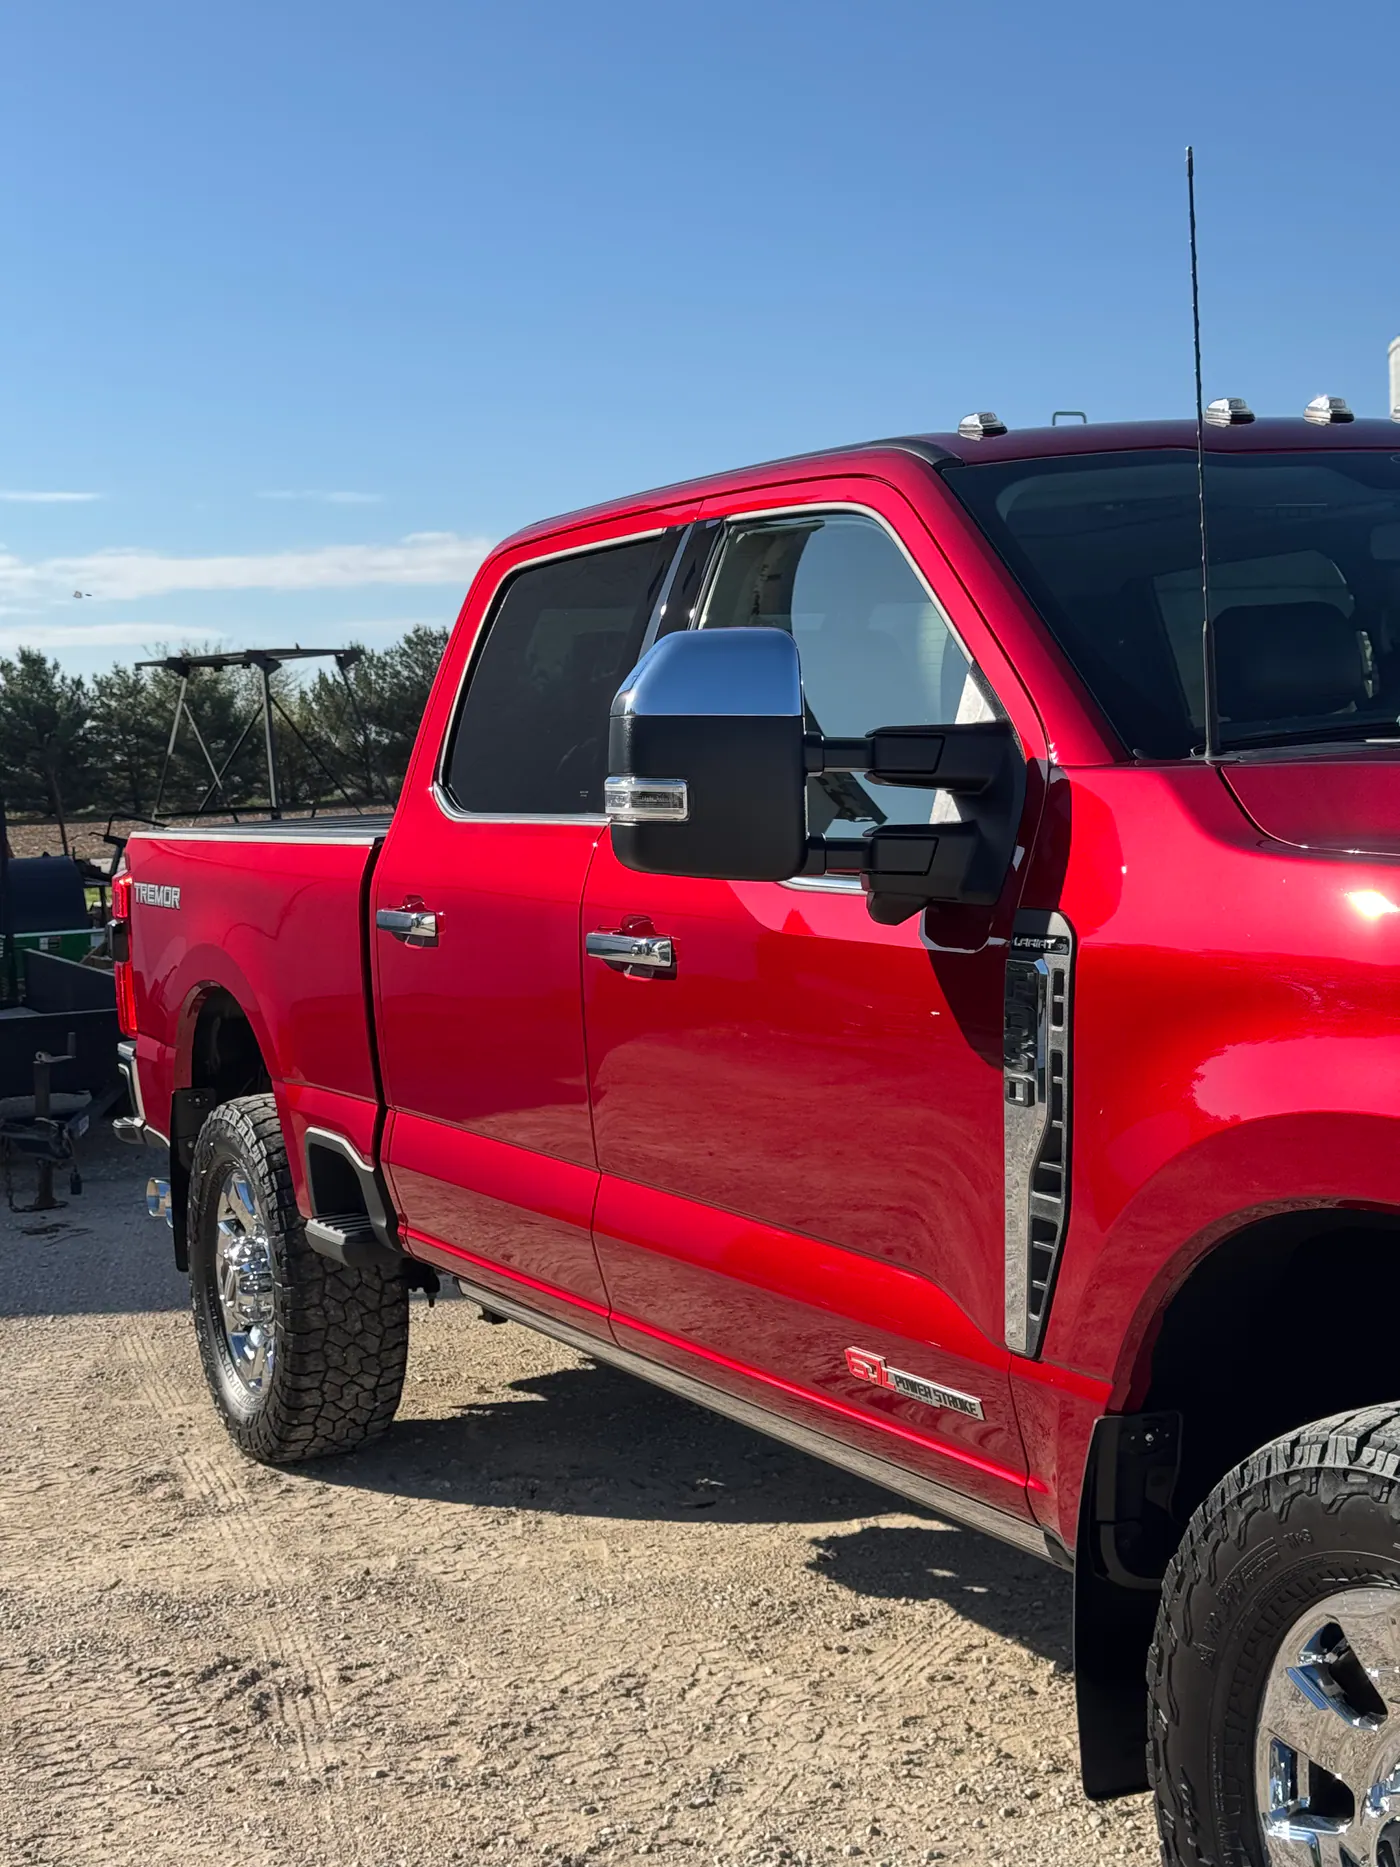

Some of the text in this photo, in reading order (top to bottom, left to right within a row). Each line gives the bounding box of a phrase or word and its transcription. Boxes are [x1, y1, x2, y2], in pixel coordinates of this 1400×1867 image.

[134, 882, 180, 909] TREMOR
[1014, 937, 1057, 949] LARIAT
[894, 1375, 932, 1398] POWER
[932, 1389, 978, 1416] STROKE
